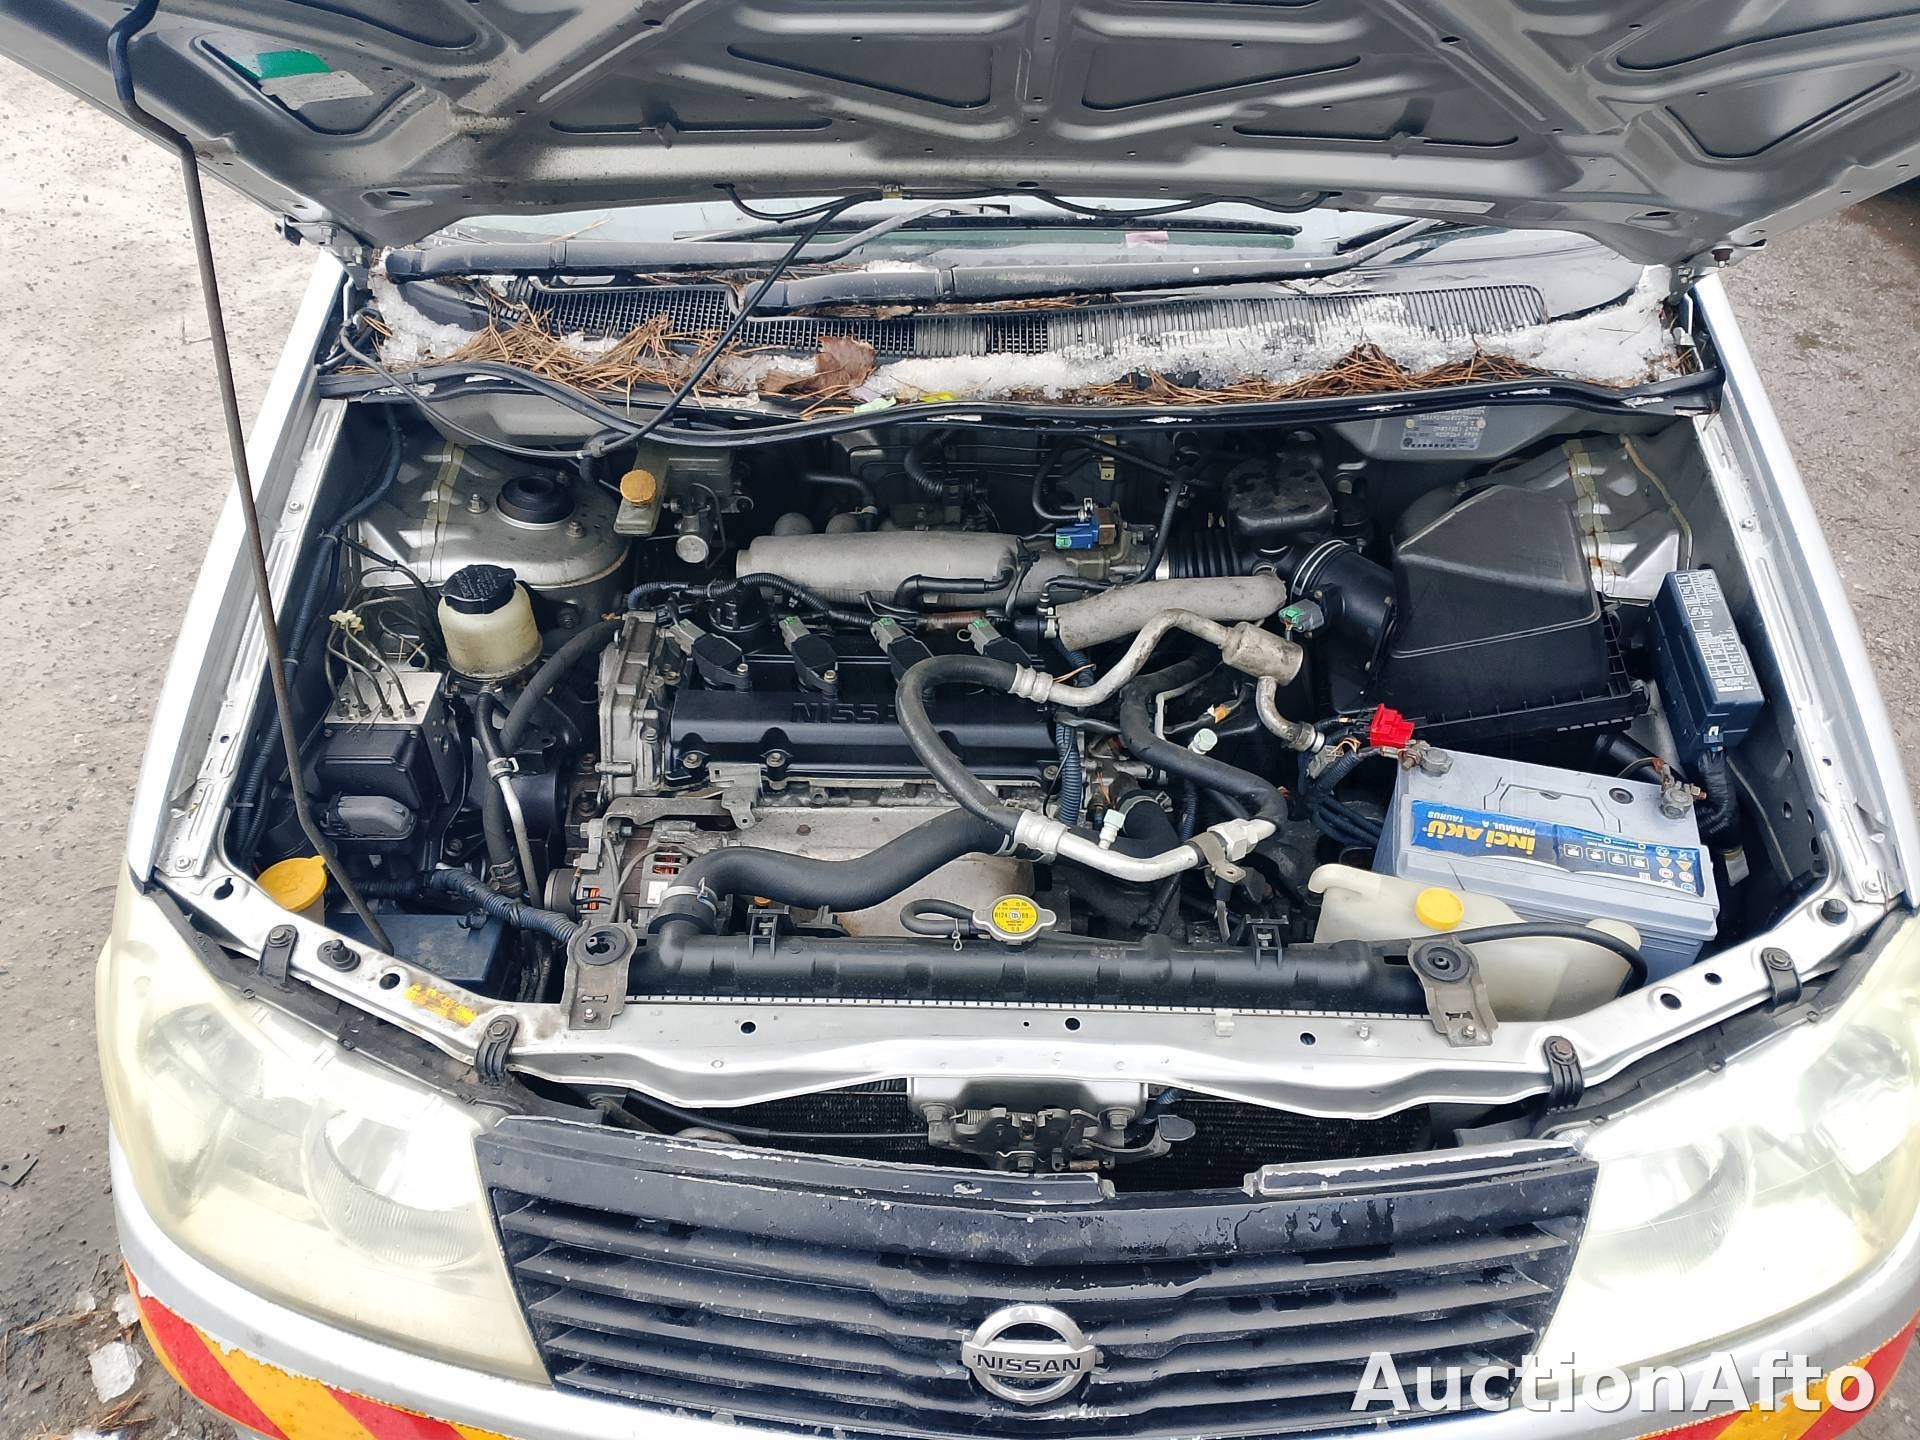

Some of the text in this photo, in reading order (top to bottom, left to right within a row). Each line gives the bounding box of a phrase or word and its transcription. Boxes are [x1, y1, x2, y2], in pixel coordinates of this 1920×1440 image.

[793, 702, 897, 723] NISS
[1427, 811, 1463, 823] TAURUS
[1494, 822, 1536, 836] FORMUL
[977, 1354, 1081, 1373] NISSAN
